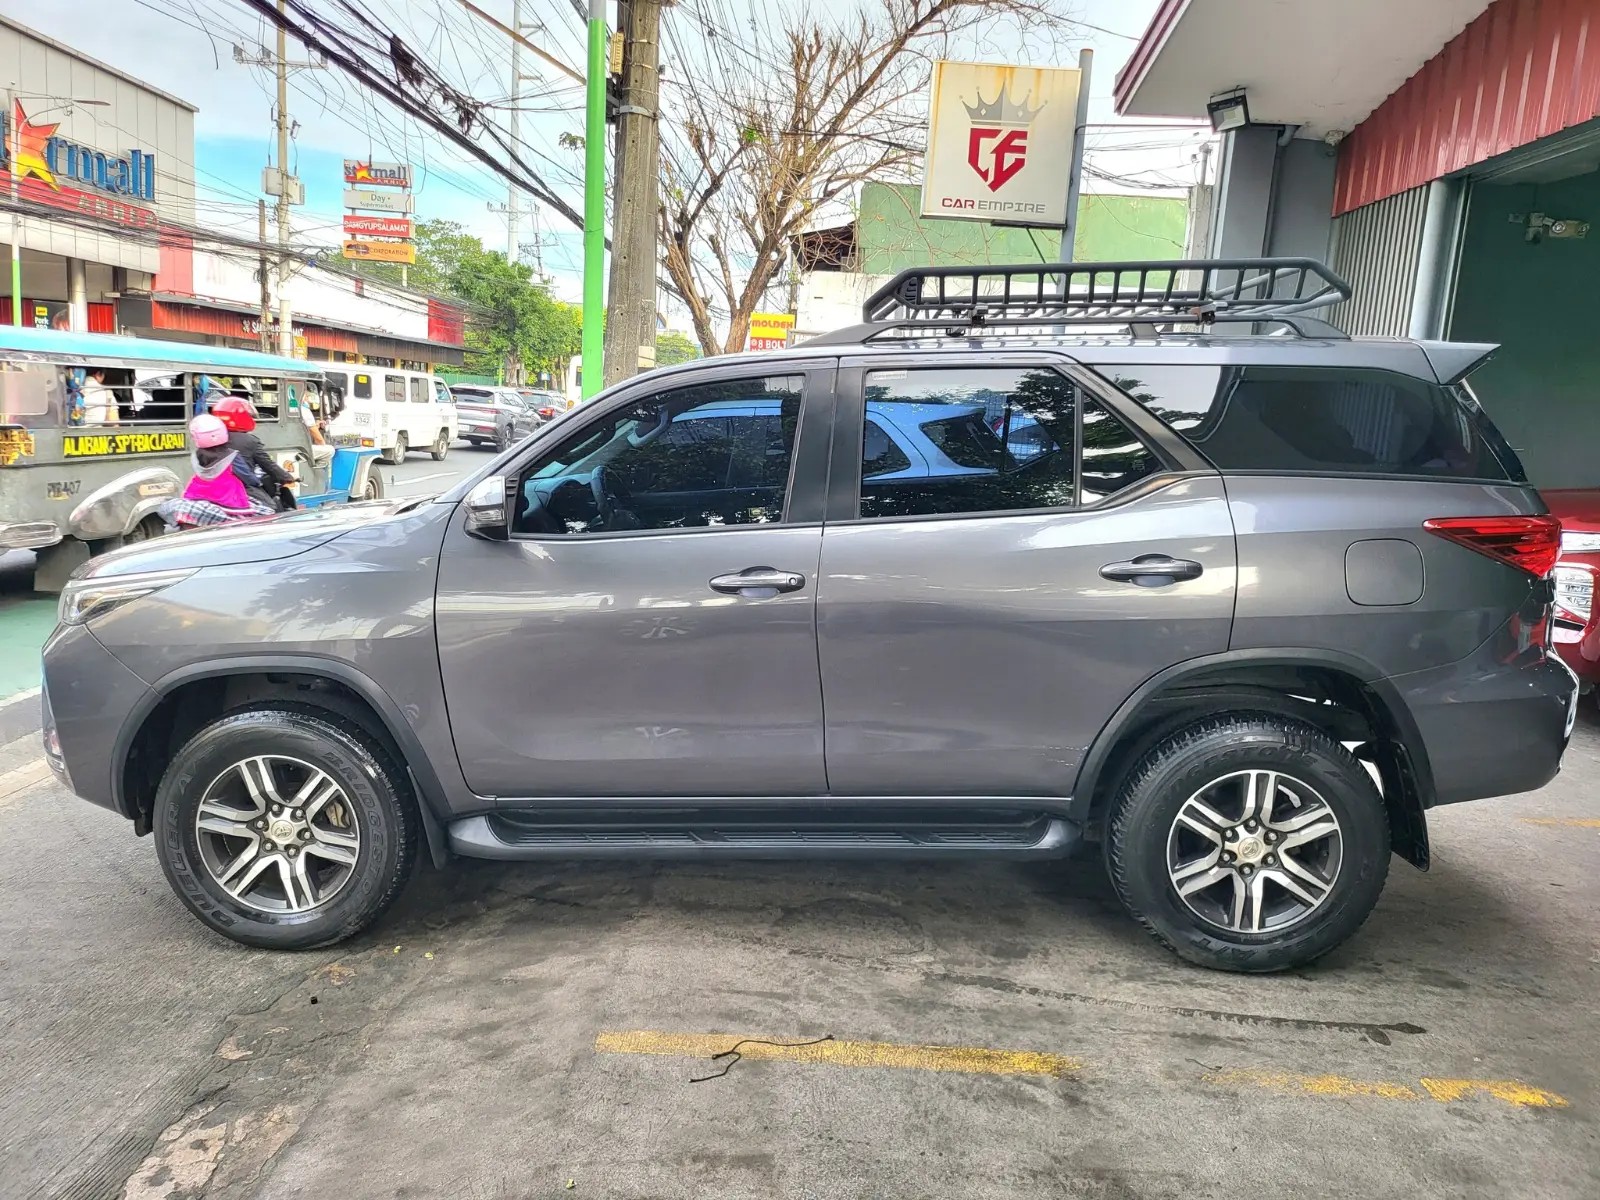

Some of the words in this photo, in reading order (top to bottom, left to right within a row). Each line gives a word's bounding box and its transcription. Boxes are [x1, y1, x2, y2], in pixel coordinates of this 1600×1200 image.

[371, 193, 386, 203] Day
[942, 197, 975, 209] CAR
[977, 200, 1046, 213] EMPIRE
[344, 220, 408, 232] SAMGYUPSALAMAT
[765, 340, 787, 350] BOLT
